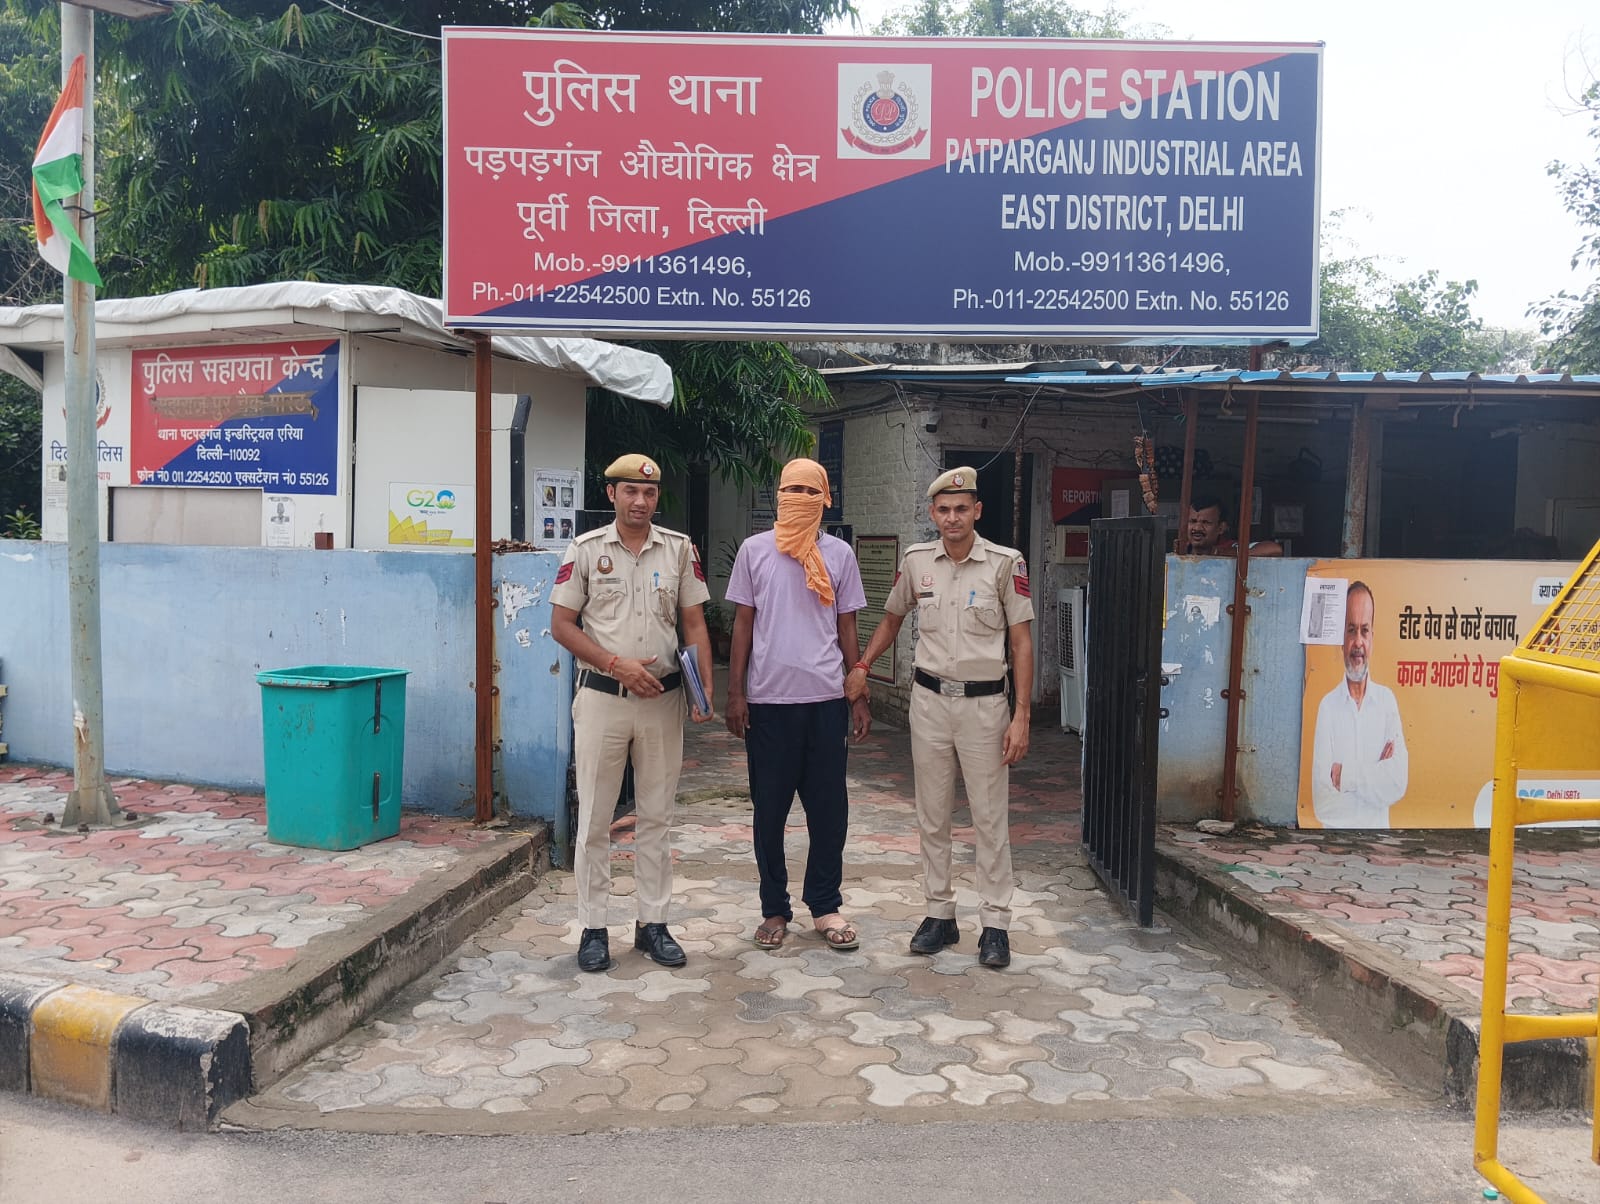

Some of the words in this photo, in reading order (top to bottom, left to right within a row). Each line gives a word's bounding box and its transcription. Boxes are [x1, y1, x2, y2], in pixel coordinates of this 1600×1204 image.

[522, 59, 640, 127] पुलिस
[669, 75, 762, 116] थाना
[971, 66, 1107, 119] POLICE
[1119, 68, 1281, 122] STATION
[464, 142, 602, 182] पड़पड़गंज
[620, 140, 753, 181] औद्योगिक
[772, 144, 820, 182] क्षेत्र
[945, 138, 1096, 175] PATPARGANJ
[1102, 140, 1235, 177] INDUSTRIAL
[1240, 141, 1303, 177] AREA
[517, 193, 569, 241] पूर्वी
[588, 196, 670, 238] जिला,
[687, 198, 768, 235] दिल्ली
[1001, 194, 1060, 230] EAST
[1065, 195, 1173, 237] DISTRICT,
[1179, 196, 1244, 231] DELHI
[534, 253, 752, 278] Mob.-9911361496,
[1014, 251, 1231, 276] Mob.-9911361496,
[473, 282, 650, 305] Ph.-011-22542500
[658, 287, 705, 306] Extn.
[712, 288, 744, 307] No.
[751, 289, 811, 307] 55126
[953, 288, 1129, 311] Ph.-011-22542500
[1136, 290, 1183, 311] Extn.
[1191, 290, 1223, 312] No.
[1229, 290, 1289, 312] 55126
[142, 353, 194, 395] पुलिस
[200, 356, 273, 384] सहायता
[280, 346, 326, 379] केन्द्र
[158, 428, 177, 440] थाना
[180, 425, 222, 443] पटपड़गंज
[277, 424, 303, 442] एरिया
[137, 466, 154, 482] फोन
[300, 473, 328, 485] 55126
[407, 489, 456, 509] G20
[1399, 605, 1422, 639] हीट
[1424, 606, 1442, 640] वेव
[1445, 606, 1458, 640] से
[1461, 607, 1482, 640] करें
[1484, 615, 1519, 646] बचाव,
[1397, 661, 1428, 687] काम
[1431, 653, 1470, 687] आएंगे
[1472, 654, 1484, 687] ये
[1546, 790, 1562, 799] Delhi
